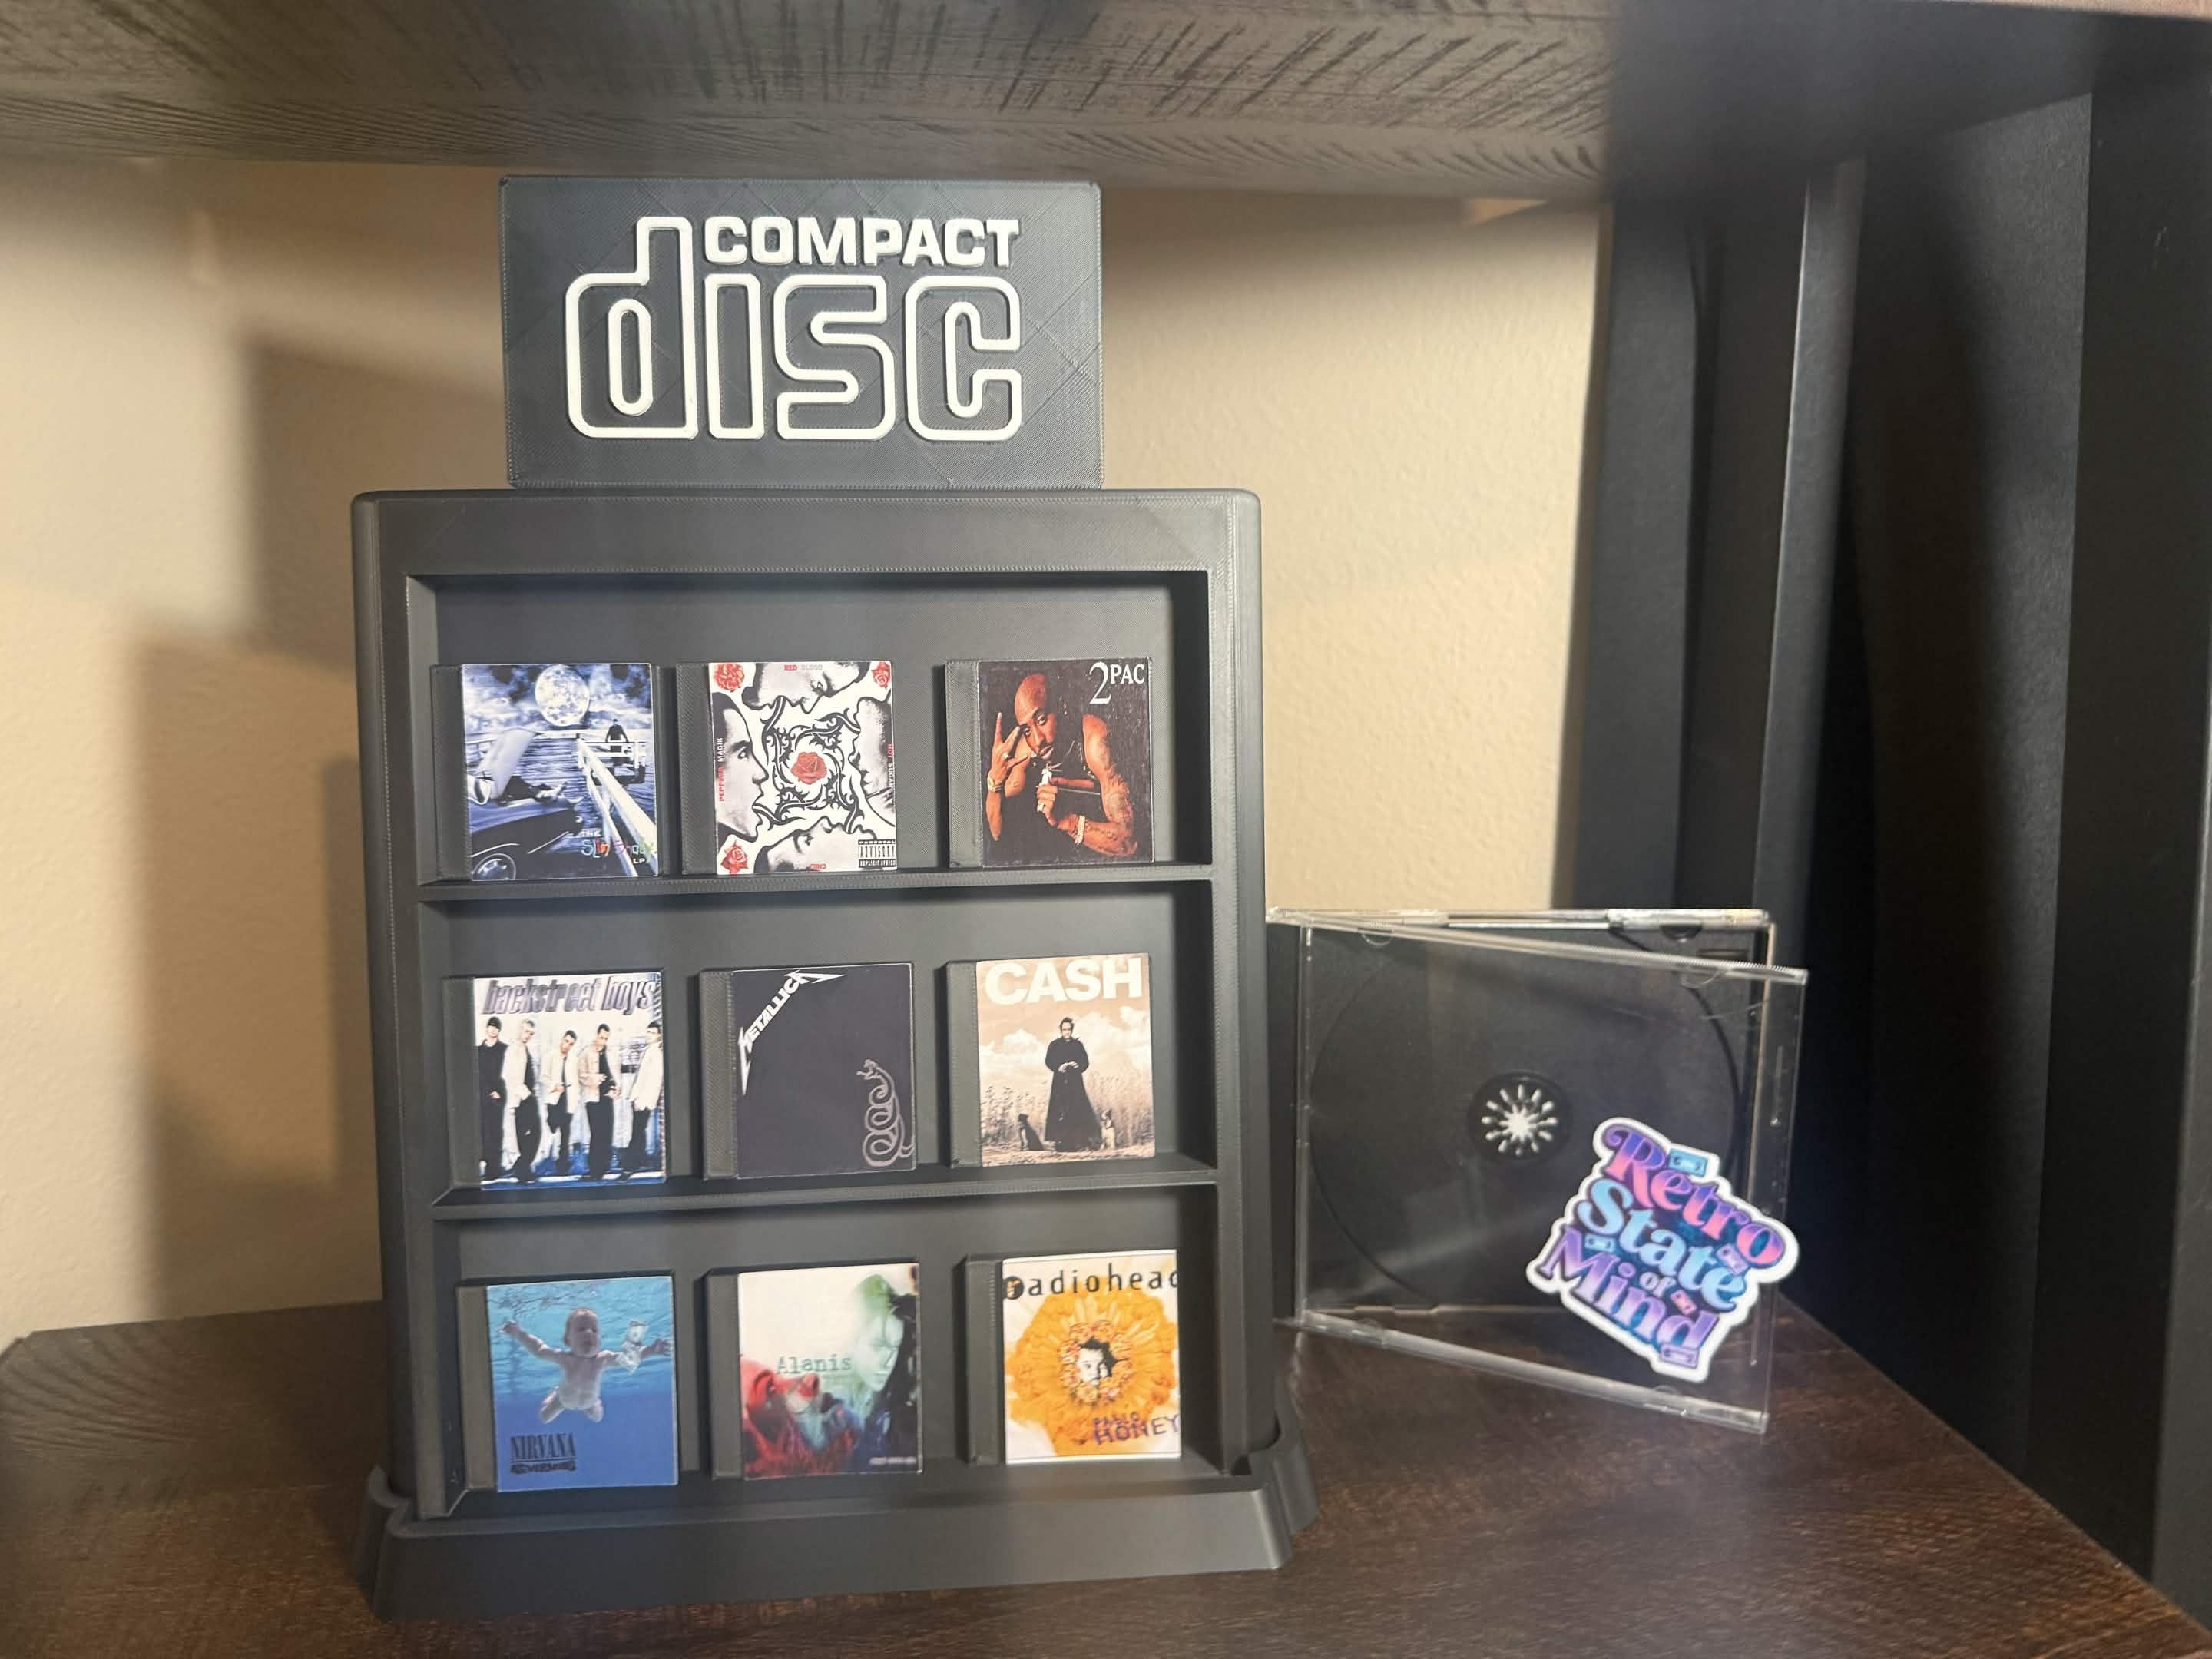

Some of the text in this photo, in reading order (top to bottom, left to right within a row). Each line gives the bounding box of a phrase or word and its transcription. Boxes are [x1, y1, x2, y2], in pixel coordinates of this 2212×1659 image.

[704, 216, 1019, 267] COMPACT
[565, 216, 1022, 441] disc
[1089, 661, 1144, 704] 2PAC
[482, 975, 656, 1015] backstreet boys
[983, 957, 1143, 1005] CASH
[737, 969, 845, 1096] METALLICA
[1604, 1124, 1786, 1267] Retro
[1577, 1178, 1747, 1312] State
[1537, 1227, 1720, 1351] Mind
[1639, 1273, 1676, 1296] of
[776, 1353, 853, 1374] Alanis
[510, 1432, 576, 1459] NIRVANA
[1093, 1413, 1181, 1445] HONEY
